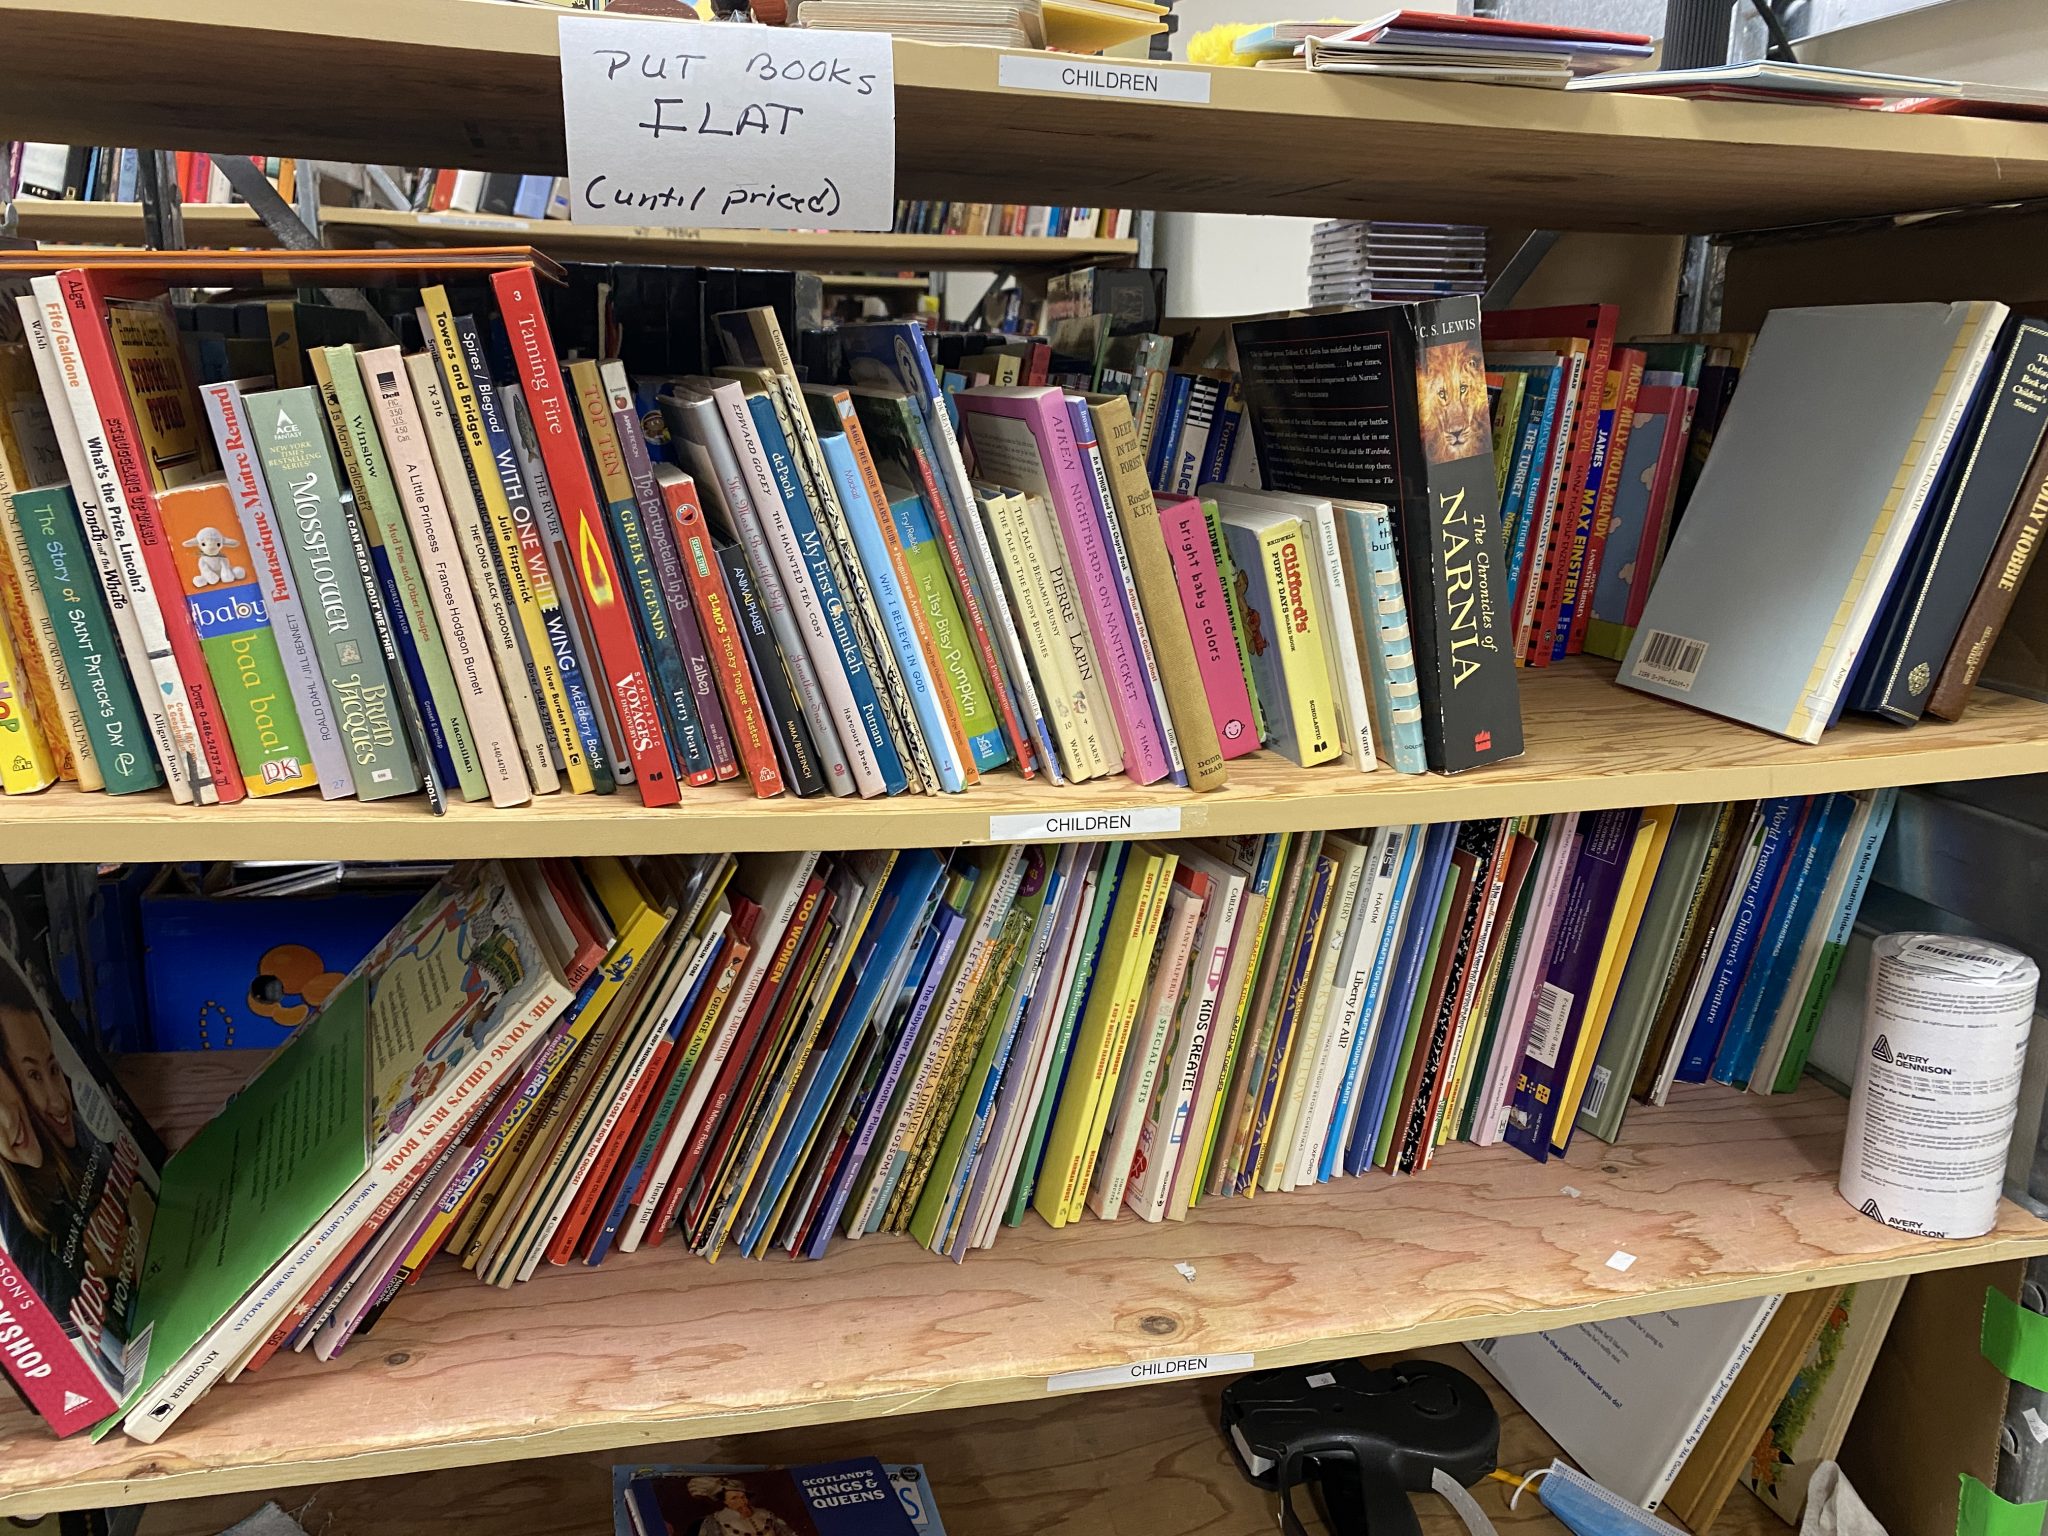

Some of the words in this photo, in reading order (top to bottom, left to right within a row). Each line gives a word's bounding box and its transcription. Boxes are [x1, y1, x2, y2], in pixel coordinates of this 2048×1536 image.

[594, 50, 707, 80] PUT
[1062, 68, 1158, 92] CHILDREN
[640, 98, 804, 137] FLAT
[586, 176, 704, 211] (until
[68, 280, 85, 309] Alger
[513, 291, 522, 301] 3
[31, 319, 48, 350] Walsh
[46, 303, 80, 388] Fife/Galdone
[772, 329, 788, 366] Cinderella
[1420, 325, 1429, 338] C.
[1431, 324, 1440, 336] S.
[1442, 318, 1476, 334] LEWIS
[436, 312, 456, 360] Towers
[451, 365, 468, 390] and
[460, 393, 482, 447] Bridges
[463, 332, 482, 371] Spires
[479, 384, 504, 433] Blegvad
[518, 313, 549, 390] Taming
[542, 395, 562, 434] Fire
[210, 388, 245, 453] Renard
[276, 424, 300, 434] ACE
[584, 384, 607, 430] TOP
[599, 430, 622, 478] TEN
[87, 437, 107, 480] What's
[353, 415, 377, 478] Winslow
[732, 403, 757, 457] EDWARD
[752, 457, 772, 496] GOREY
[1052, 416, 1075, 471] AIKEN
[1593, 429, 1608, 468] JAMES
[407, 464, 417, 473] A
[410, 475, 424, 503] Little
[772, 452, 795, 500] dePaola
[102, 481, 118, 503] the
[1578, 489, 1596, 529] MAX
[34, 505, 55, 535] The
[106, 505, 125, 541] Prize,
[419, 504, 439, 553] Princess
[1070, 483, 1104, 582] NIGHTBIRDS
[1472, 514, 1485, 546] The
[46, 542, 72, 582] Story
[119, 543, 145, 593] Lincoln?
[289, 472, 349, 635] MOSSFLOWER
[496, 449, 524, 501] WITH
[512, 503, 539, 548] ONE
[527, 554, 559, 614] WHITE
[546, 618, 575, 671] WING
[497, 515, 511, 544] Julie
[507, 545, 530, 603] Fitzpatrick
[1322, 521, 1336, 557] Jeremy
[1330, 557, 1341, 588] Fisher
[1563, 530, 1589, 605] EINSTEIN
[1998, 525, 2039, 592] HOBBIE
[62, 588, 80, 603] of
[620, 510, 642, 566] GREEK
[638, 570, 667, 640] LEGENDS
[922, 575, 932, 591] The
[1098, 586, 1111, 604] ON
[1179, 520, 1199, 570] bright
[1192, 571, 1206, 610] baby
[1203, 618, 1220, 662] colors
[1272, 552, 1285, 584] PUPPY
[1279, 585, 1290, 615] DAYS
[1281, 543, 1308, 634] Clifford's
[1439, 486, 1482, 689] NARNIA
[1476, 552, 1494, 630] Chronicles
[198, 597, 269, 626] baby
[708, 592, 726, 634] ELMO'S
[734, 567, 765, 636] ANIMALPHABET
[802, 531, 820, 555] My
[812, 556, 833, 597] First
[826, 598, 863, 676] Chanukah
[927, 592, 944, 619] Itsy
[68, 609, 94, 652] SAINT
[436, 562, 454, 607] Frances
[450, 607, 470, 655] Hodgson
[464, 655, 483, 696] Burnett
[880, 573, 892, 597] WHY
[891, 609, 911, 650] BELIEVE
[906, 655, 917, 667] IN
[912, 669, 925, 693] GOD
[935, 618, 953, 650] Bitsy
[1050, 566, 1075, 624] PIERRE
[1069, 631, 1093, 681] LAPIN
[1481, 634, 1497, 652] of
[721, 635, 736, 669] Tricky
[1104, 612, 1138, 701] NANTUCKET
[83, 654, 113, 717] PATRICK'S
[232, 635, 259, 688] baa
[250, 694, 289, 754] baa!
[691, 657, 710, 695] Zalben
[727, 670, 749, 706] Tongue
[947, 650, 976, 717] Pumpkin
[105, 721, 124, 748] DAY
[332, 674, 376, 765] JACQUES
[360, 682, 394, 748] BRIAN
[570, 684, 592, 737] McElderry
[586, 739, 603, 769] Books
[673, 688, 691, 724] Terry
[684, 725, 700, 761] Deary
[744, 701, 761, 748] Twisters
[863, 703, 884, 748] Putnam
[153, 713, 172, 753] Alligator
[166, 755, 180, 782] Books
[450, 717, 473, 773] Macmillan
[842, 708, 862, 749] Harcourt
[858, 749, 872, 776] Brace
[1360, 725, 1370, 756] Warne
[264, 762, 297, 781] DK
[423, 775, 438, 805] TROLL
[1200, 763, 1223, 777] MEAD
[1046, 815, 1131, 832] CHILDREN
[1770, 805, 1788, 840] World
[1751, 840, 1774, 892] Treasury
[799, 893, 816, 920] 100
[1225, 888, 1239, 924] CARLSON
[1371, 892, 1383, 924] HAKIM
[1746, 894, 1756, 910] of
[770, 926, 803, 983] WOMEN
[1725, 910, 1752, 966] Children's
[530, 995, 557, 1021] THE
[738, 967, 764, 1013] McGRAW'S
[921, 984, 935, 1000] The
[1345, 970, 1365, 1017] Liberty
[1706, 967, 1733, 1024] Literature
[696, 996, 723, 1034] GEORGE
[906, 1000, 929, 1046] Babysitter
[1196, 999, 1214, 1031] KIDS
[1344, 1006, 1354, 1029] for
[491, 1020, 533, 1061] YOUNG
[688, 1034, 704, 1060] AND
[714, 1011, 742, 1062] EMPORIUM
[1148, 1018, 1167, 1064] SPECIAL
[1338, 1028, 1351, 1049] All?
[892, 1046, 907, 1075] from
[1182, 1032, 1205, 1092] CREATE!
[1896, 1052, 1929, 1065] AVERY
[1896, 1059, 1952, 1076] DENNISON
[447, 1060, 493, 1106] CHILD'S
[874, 1071, 896, 1114] Another
[1138, 1070, 1153, 1104] GIFTS
[417, 1107, 449, 1139] BUSY
[861, 1114, 880, 1146] Planet
[382, 1138, 419, 1174] BOOK
[640, 1209, 652, 1224] Holt
[648, 1182, 665, 1211] Henry
[70, 1261, 108, 1349] KIDS
[169, 1350, 219, 1399] KINGFISHER
[1130, 1357, 1208, 1378] CHILDREN
[802, 1470, 874, 1487] SCOTLAND'S
[806, 1480, 863, 1498] KINGS
[865, 1479, 878, 1489] &
[812, 1490, 885, 1509] QUEENS
